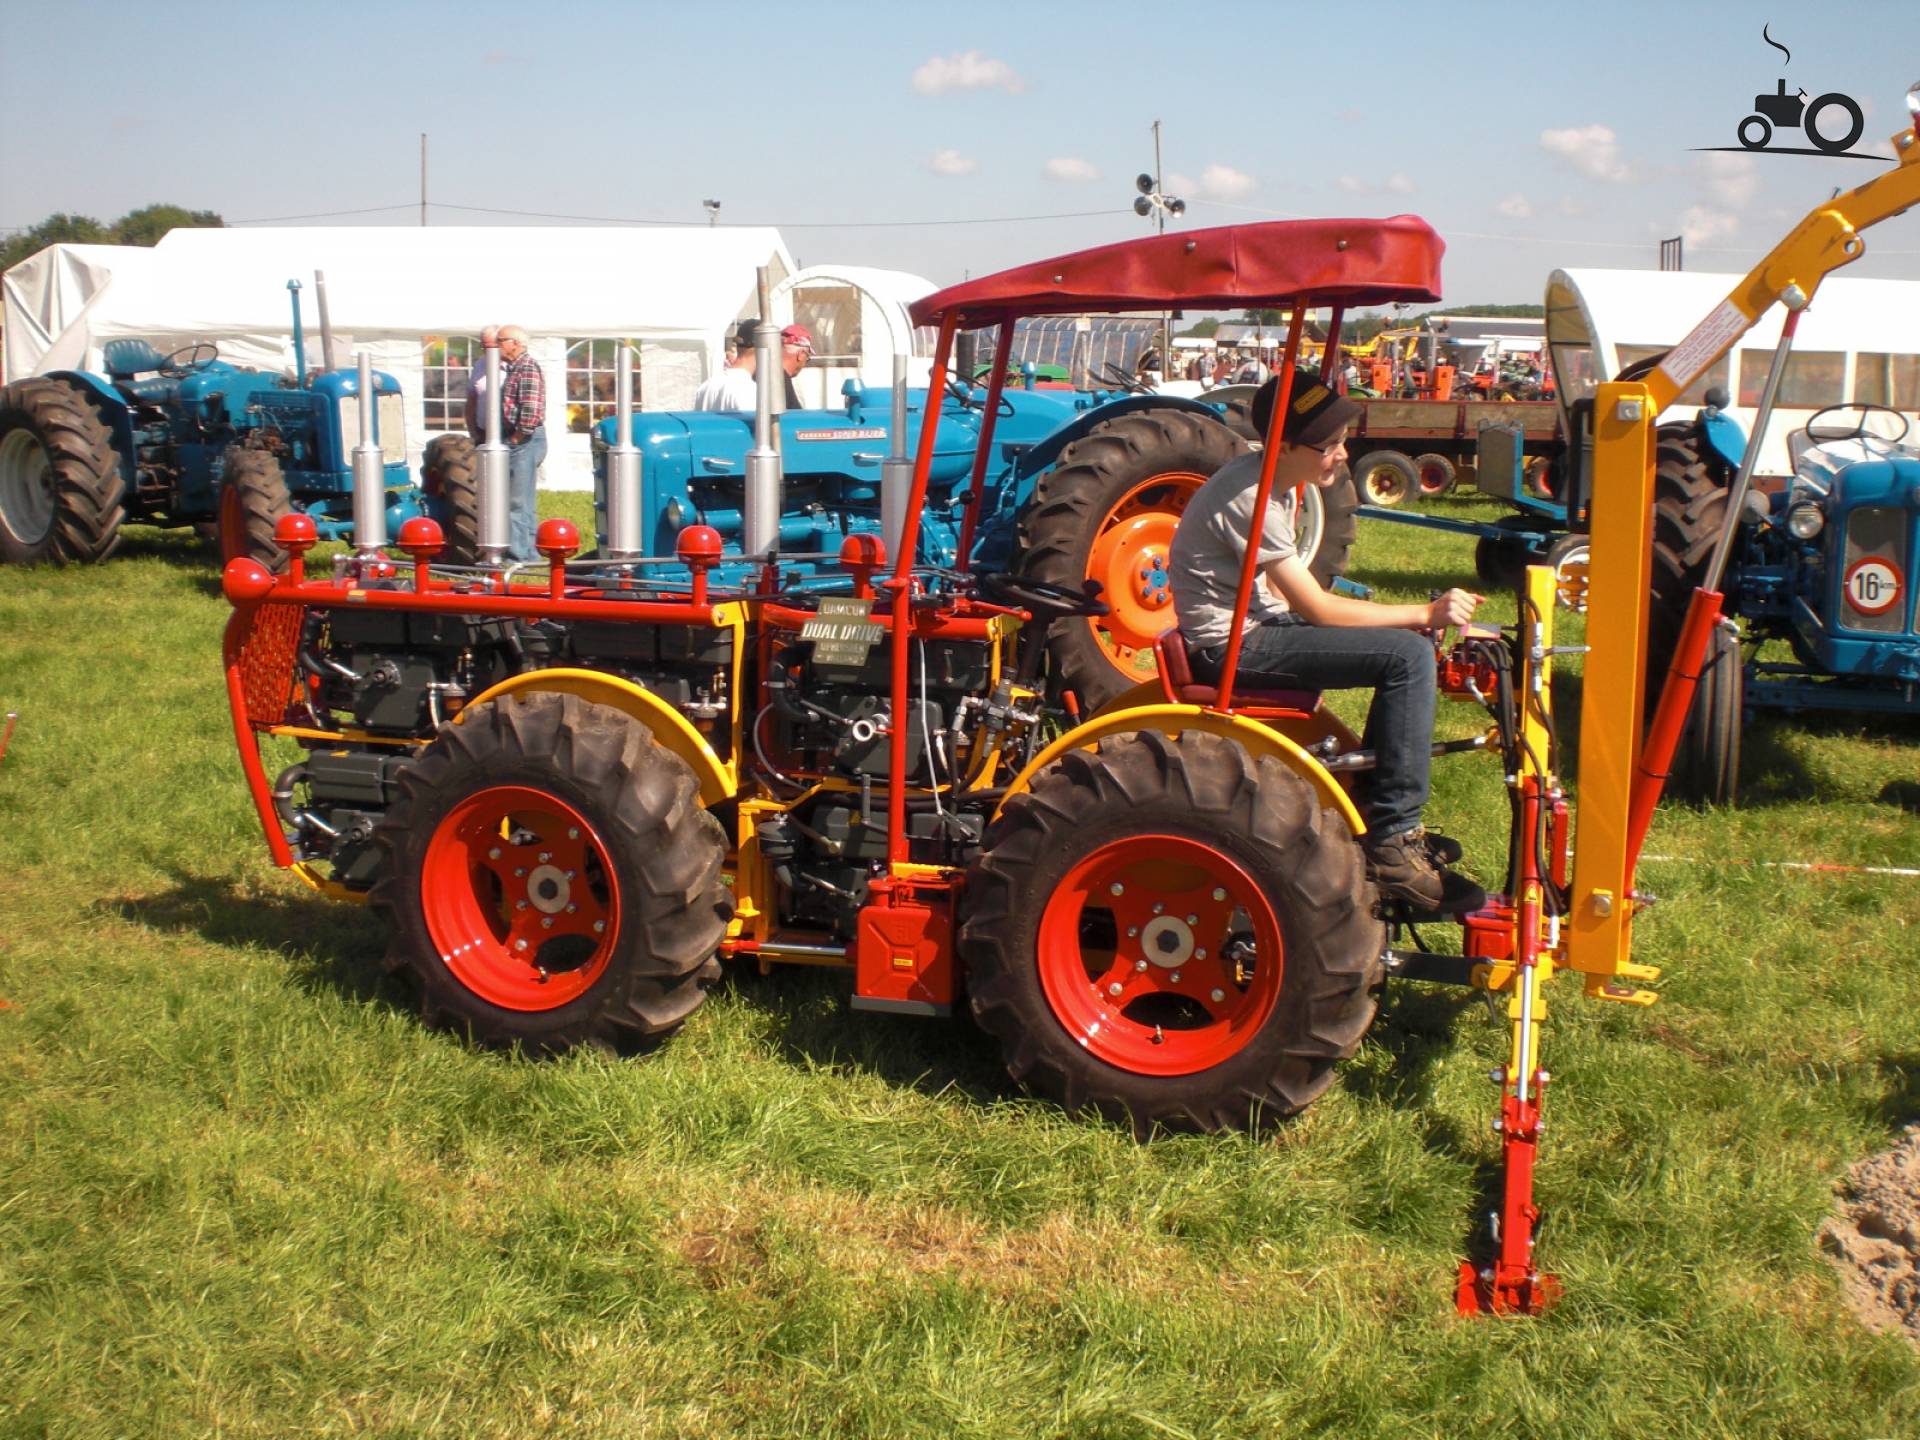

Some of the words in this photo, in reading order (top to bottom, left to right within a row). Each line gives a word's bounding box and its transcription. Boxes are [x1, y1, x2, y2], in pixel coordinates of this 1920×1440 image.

[1855, 572, 1879, 600] 16
[802, 622, 837, 639] DUAL
[840, 624, 883, 642] DRIVE
